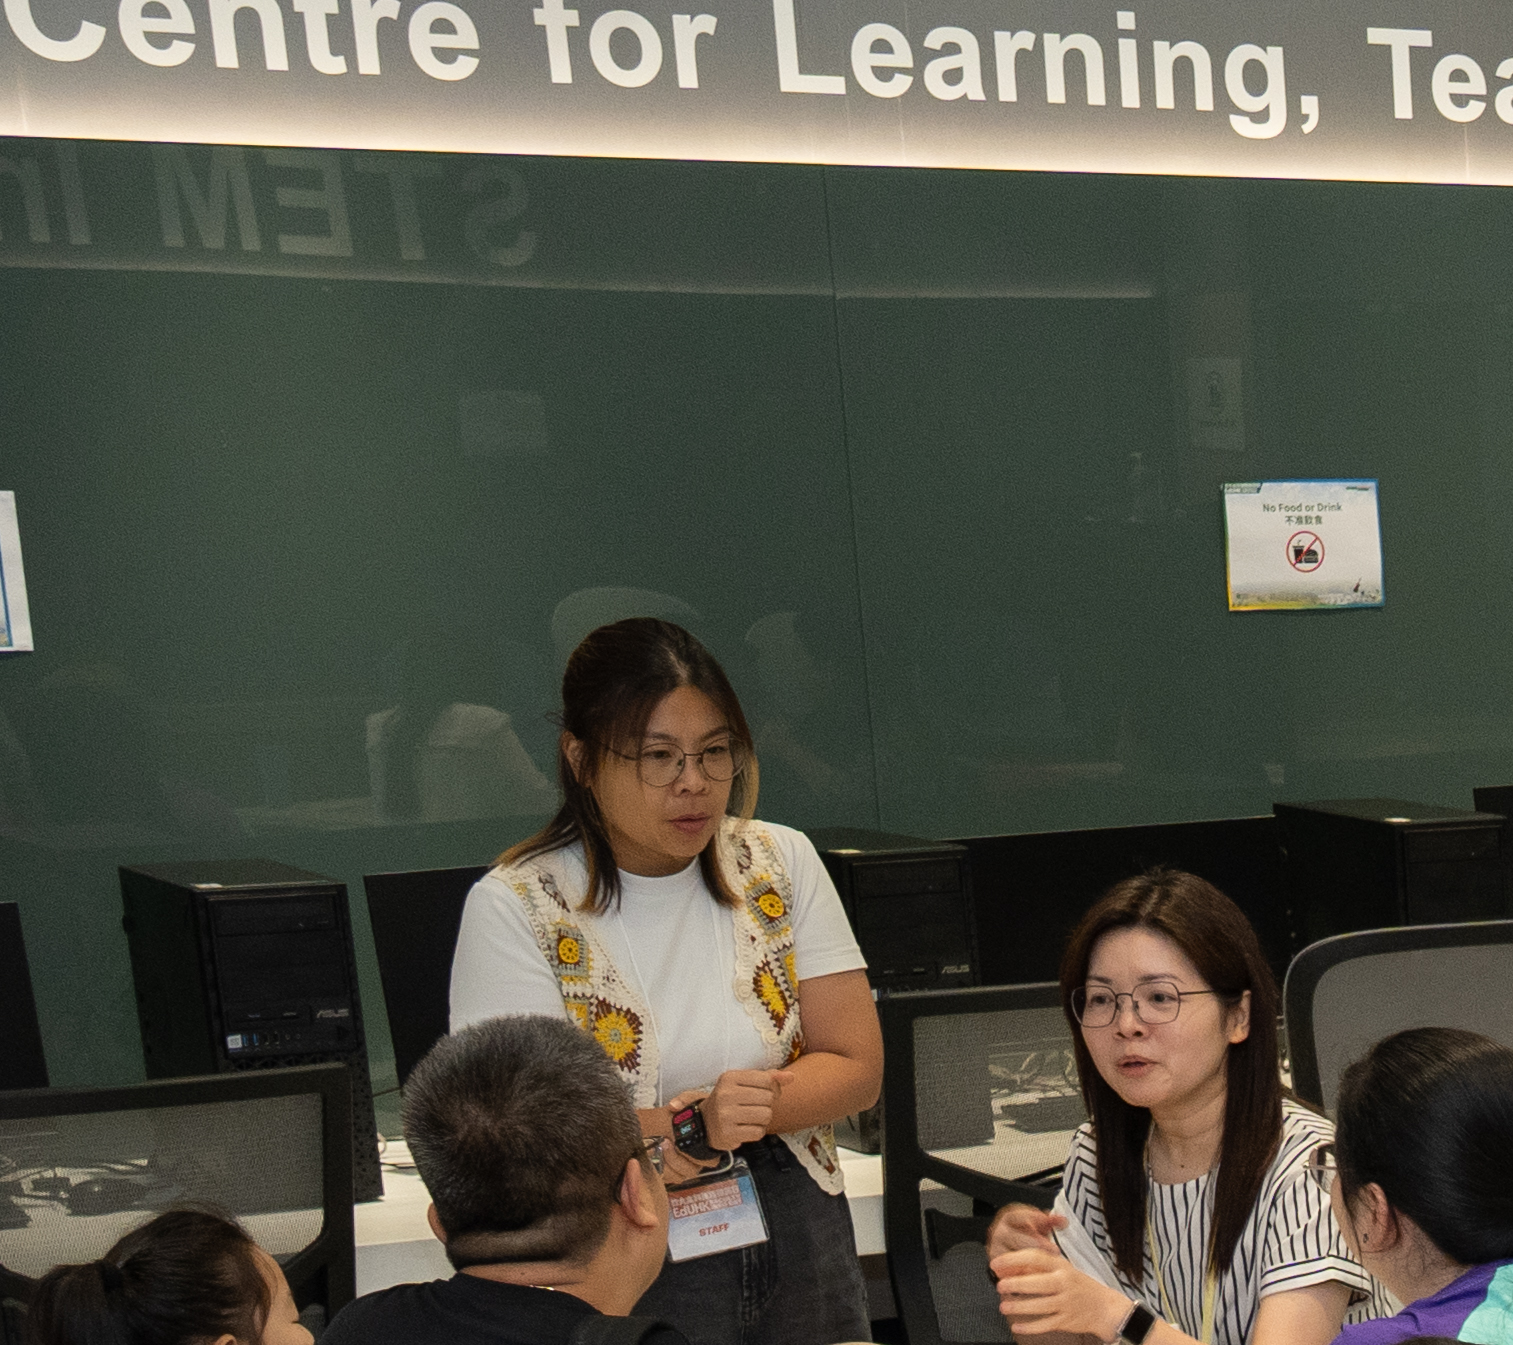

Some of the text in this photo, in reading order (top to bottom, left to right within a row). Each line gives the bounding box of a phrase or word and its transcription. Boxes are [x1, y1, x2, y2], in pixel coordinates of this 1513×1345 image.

[12, 0, 482, 82] Centre
[533, 0, 718, 90] for
[778, 0, 1321, 140] Learning,
[1262, 502, 1343, 513] No Food or Drink
[673, 1202, 710, 1218] EdUHK
[698, 1222, 729, 1237] STAFF
